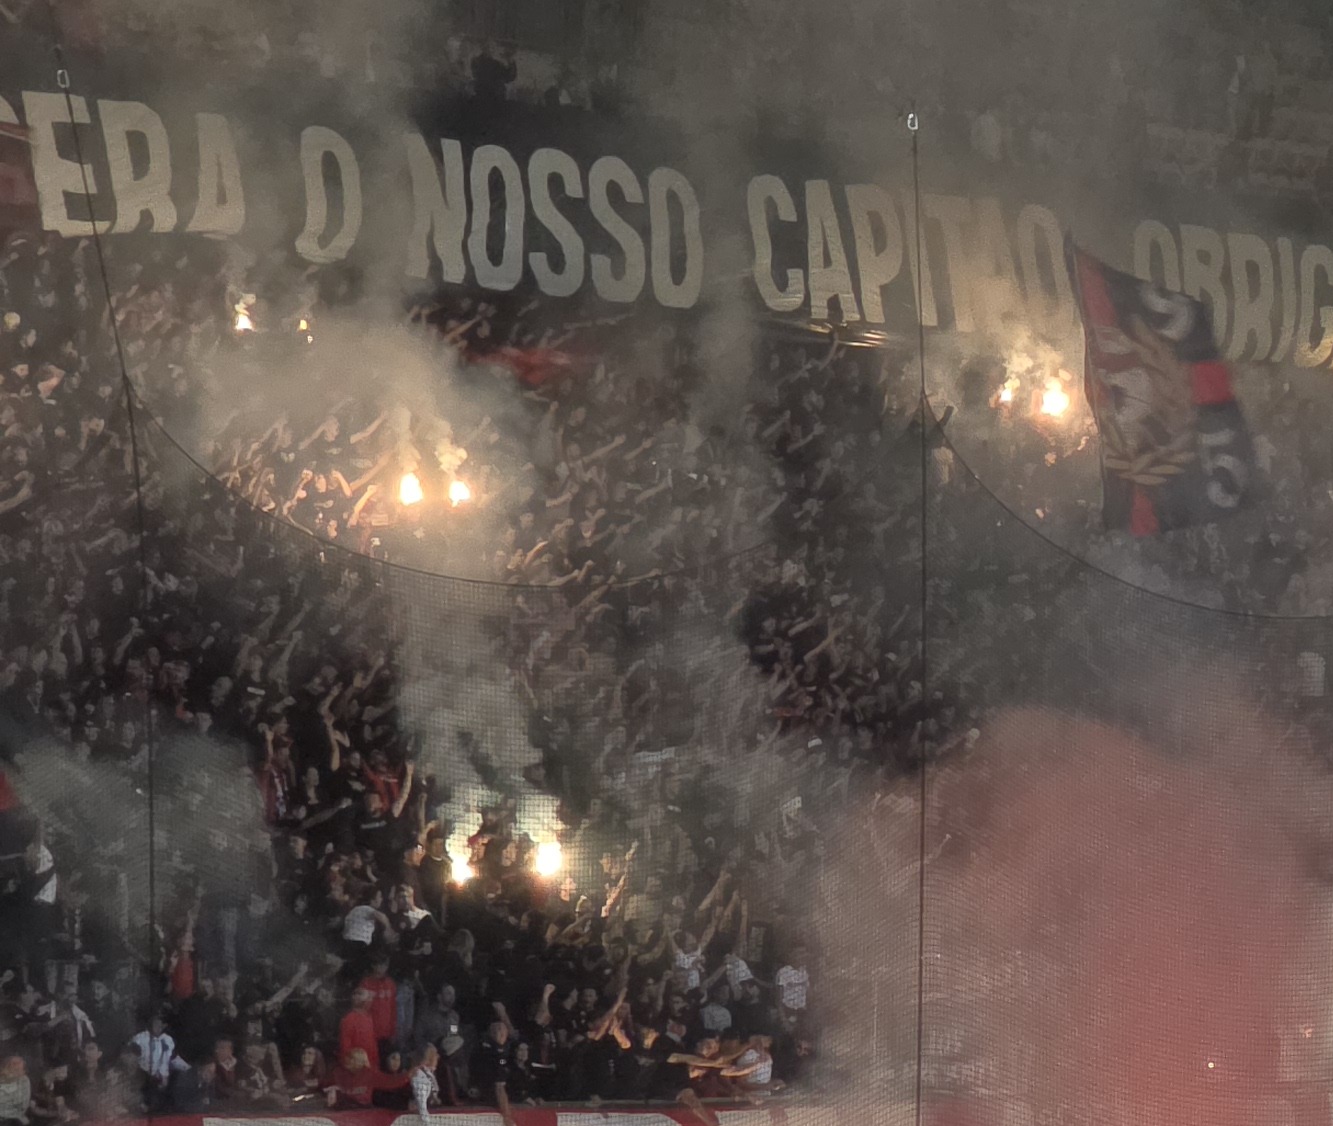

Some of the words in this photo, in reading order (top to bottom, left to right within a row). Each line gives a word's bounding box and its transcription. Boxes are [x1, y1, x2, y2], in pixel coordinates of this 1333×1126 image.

[0, 91, 246, 238] ERA
[295, 125, 362, 263] O
[406, 131, 701, 309] NOSSO
